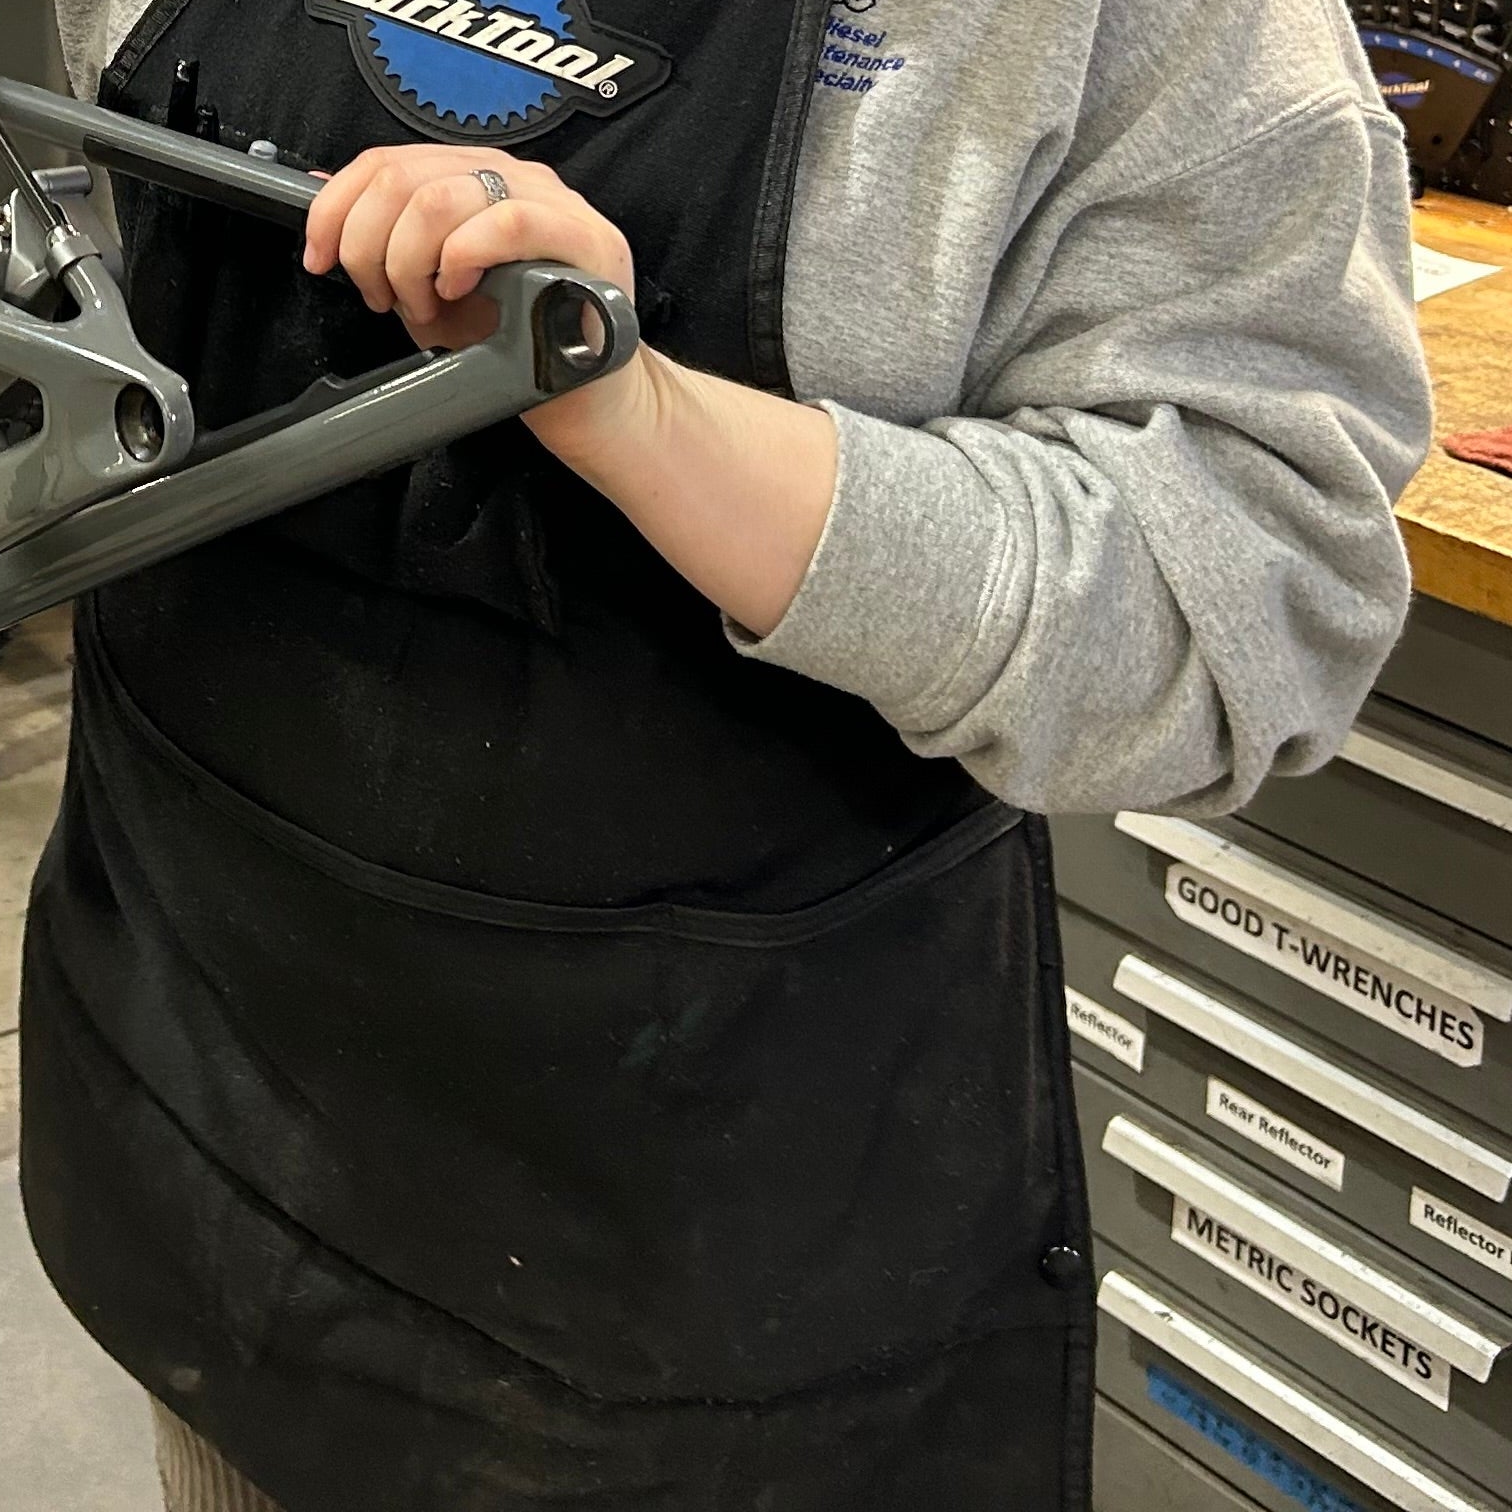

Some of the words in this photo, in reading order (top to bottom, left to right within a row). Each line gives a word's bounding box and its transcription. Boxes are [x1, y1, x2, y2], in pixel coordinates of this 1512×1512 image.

[821, 42, 906, 72] tenance
[1176, 875, 1264, 939] GOOD
[1271, 920, 1475, 1052] T-WRENCHES
[1070, 1002, 1134, 1050] Reflector
[1219, 1092, 1254, 1123] Rear
[1258, 1116, 1331, 1169] Reflector
[1424, 1203, 1505, 1259] Reflector
[1186, 1207, 1293, 1292] METRIC
[1299, 1278, 1433, 1381] SOCKETS
